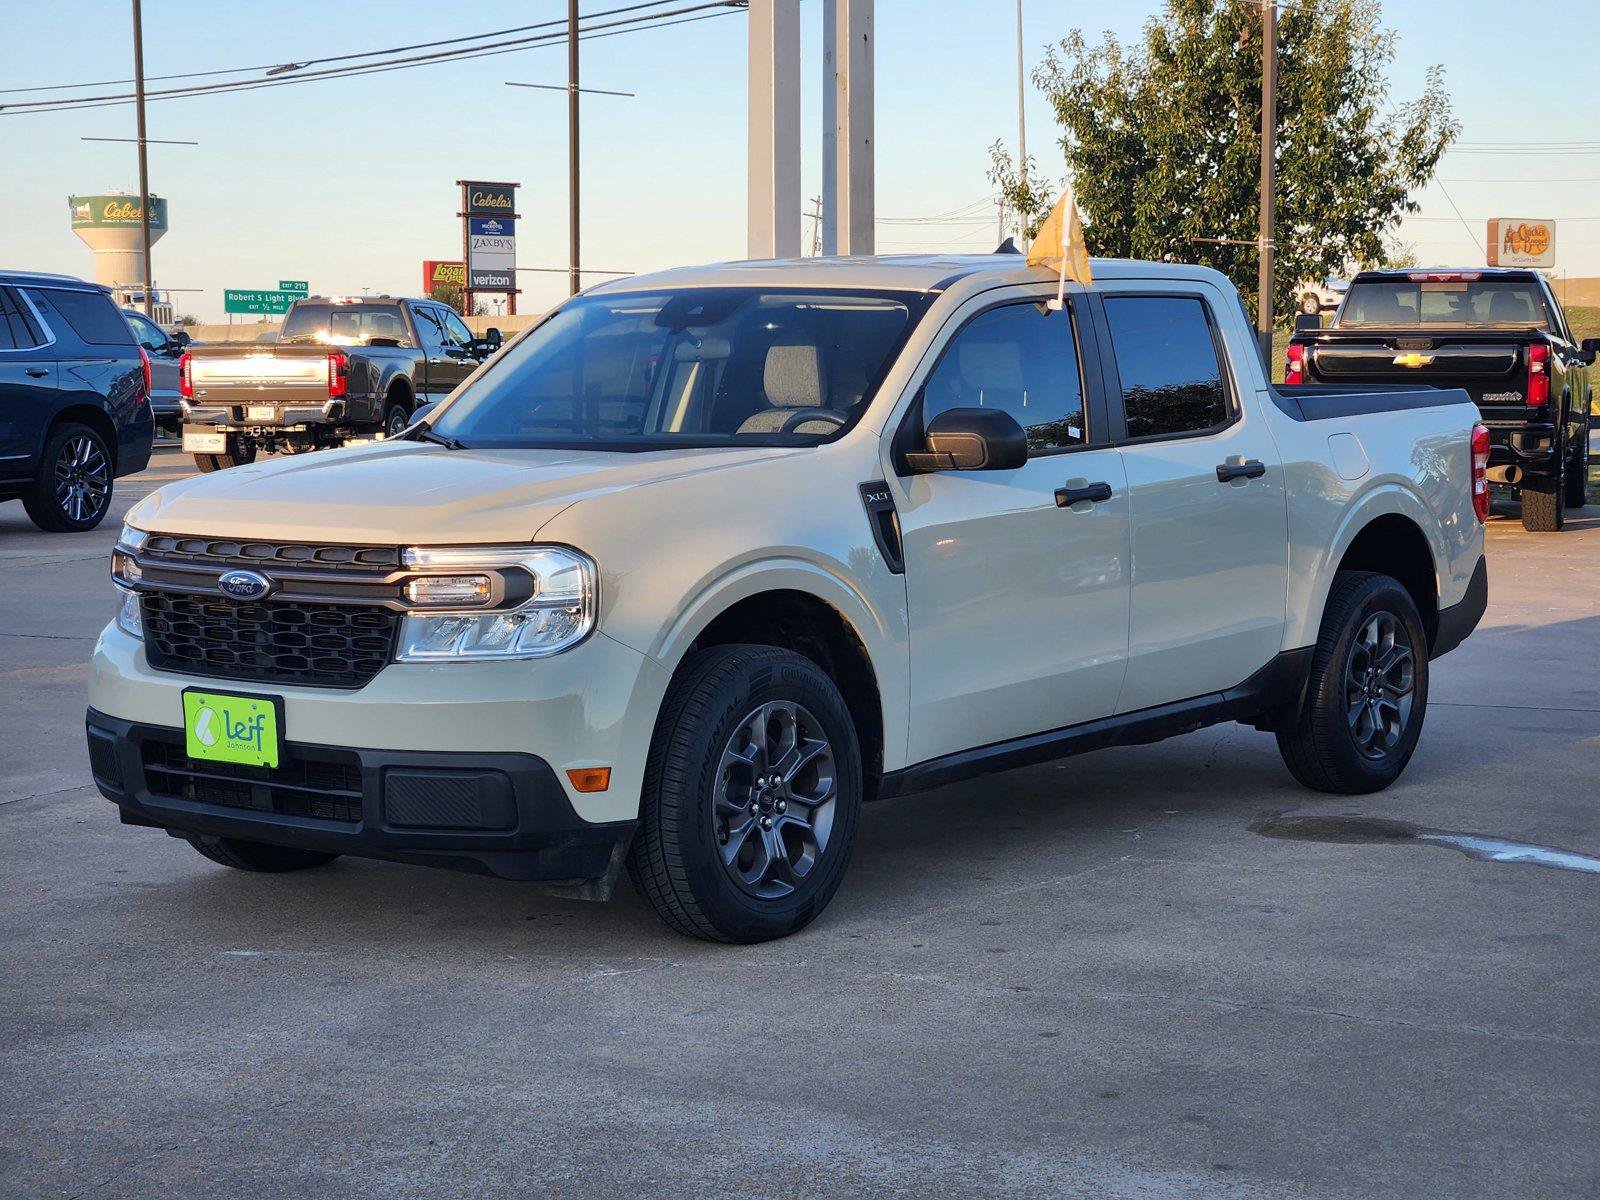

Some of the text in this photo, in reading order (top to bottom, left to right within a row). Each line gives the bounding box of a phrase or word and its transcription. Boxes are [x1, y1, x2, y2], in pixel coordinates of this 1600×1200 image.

[472, 191, 512, 208] Cabela's
[473, 238, 513, 250] ZAXBY'S
[294, 282, 306, 290] 219
[473, 274, 510, 286] verizon
[228, 293, 254, 301] Robert
[257, 294, 262, 302] S
[265, 294, 285, 303] Light
[866, 491, 891, 503] XLT
[228, 576, 255, 594] Ford
[226, 739, 256, 751] Johnson
